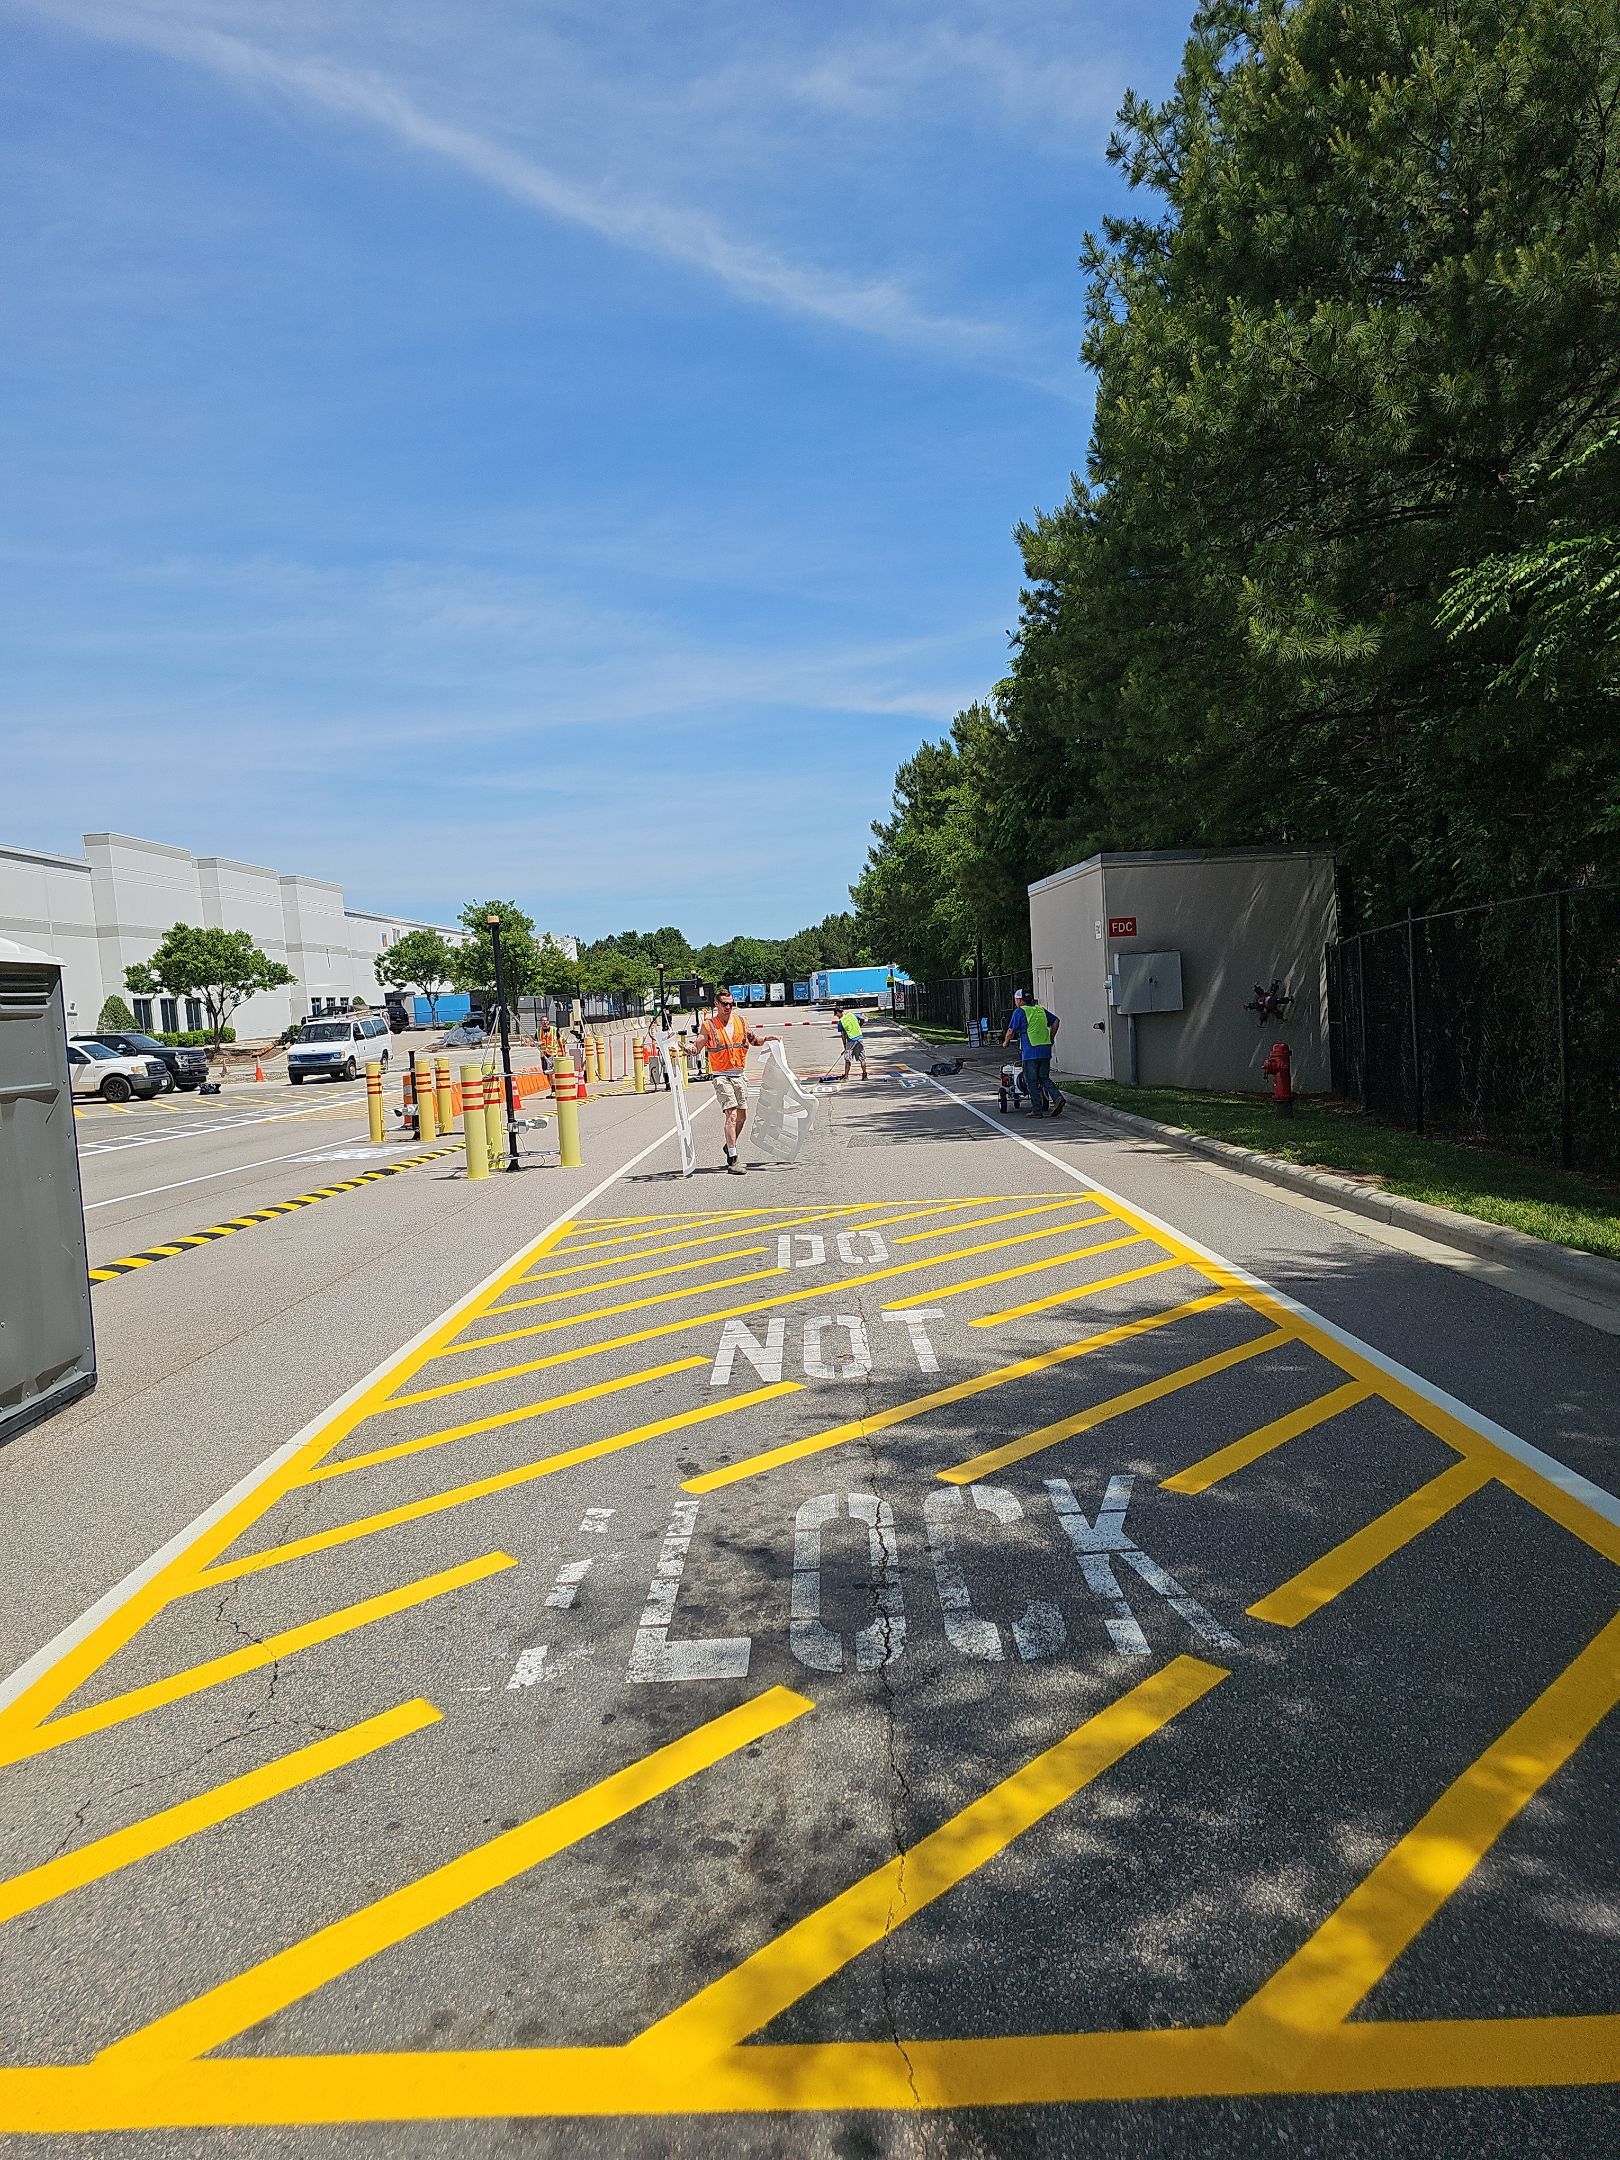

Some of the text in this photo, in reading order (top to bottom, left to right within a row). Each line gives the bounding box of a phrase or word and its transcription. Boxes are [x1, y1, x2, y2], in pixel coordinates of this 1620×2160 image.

[1111, 921, 1133, 933] FDC
[777, 1231, 889, 1268] DO
[710, 1308, 945, 1386] NOT
